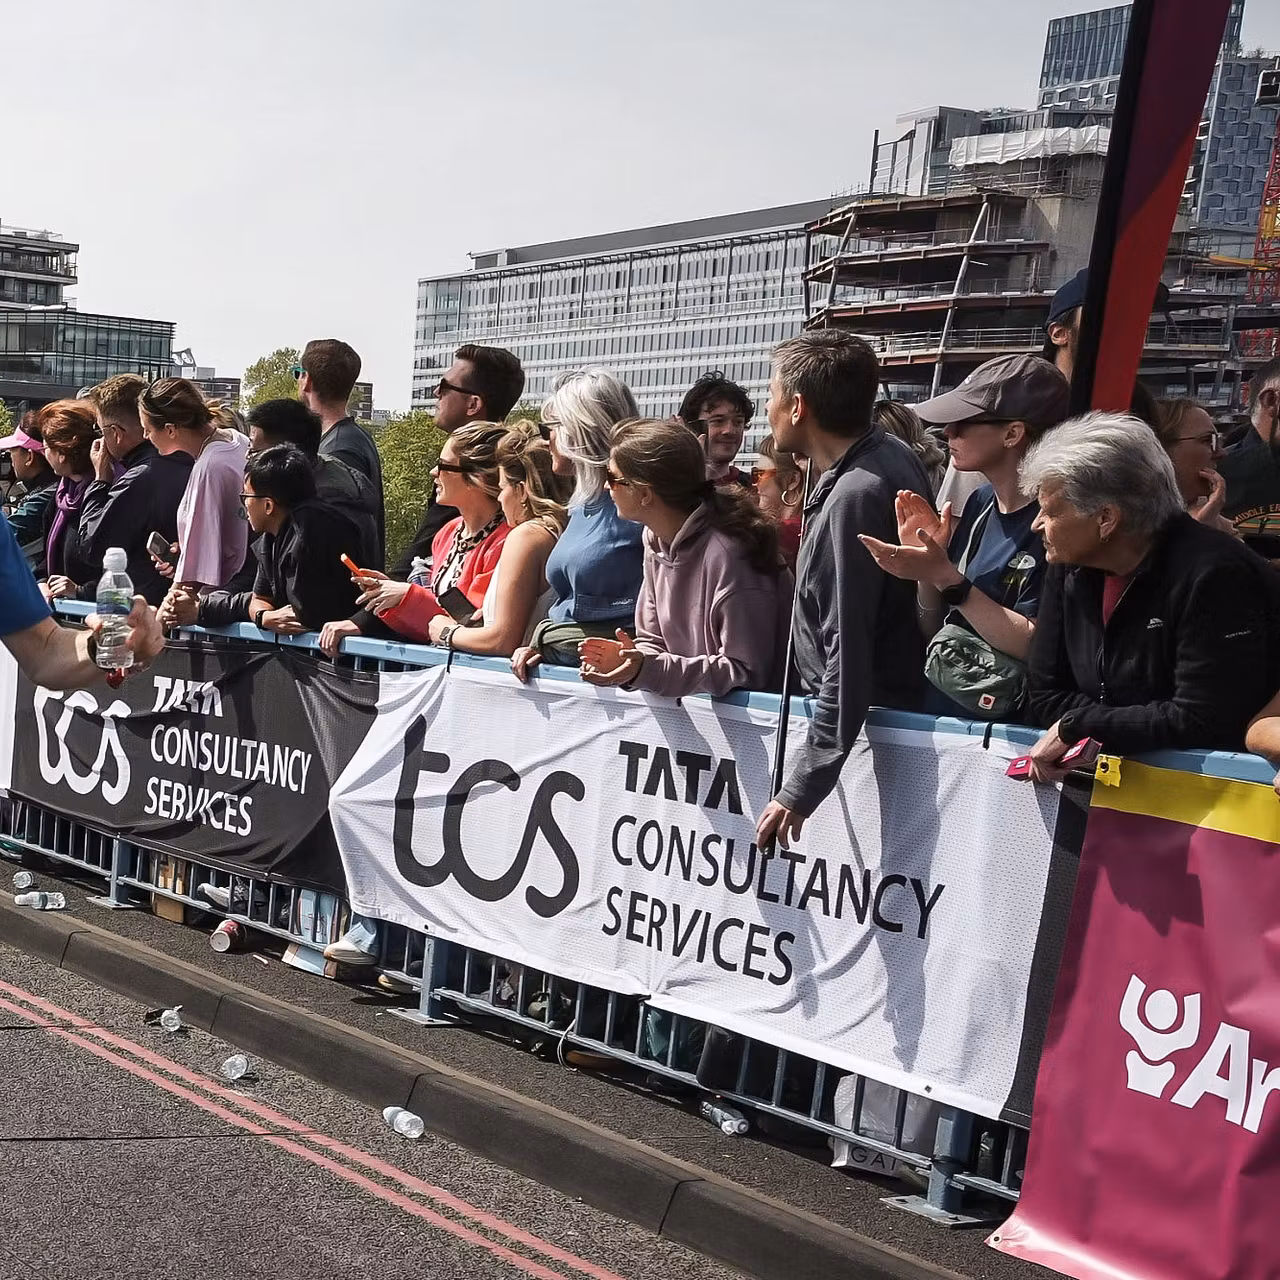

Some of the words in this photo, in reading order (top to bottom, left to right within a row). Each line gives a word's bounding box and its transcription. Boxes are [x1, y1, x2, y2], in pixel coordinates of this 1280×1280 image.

[151, 675, 224, 718] TATA
[34, 684, 132, 806] tcs
[150, 723, 312, 795] CONSULTANCY
[619, 740, 744, 815] TATA
[144, 776, 253, 837] SERVICES
[392, 713, 587, 918] tcs
[611, 814, 945, 940] CONSULTANCY
[601, 885, 795, 986] SERVICES
